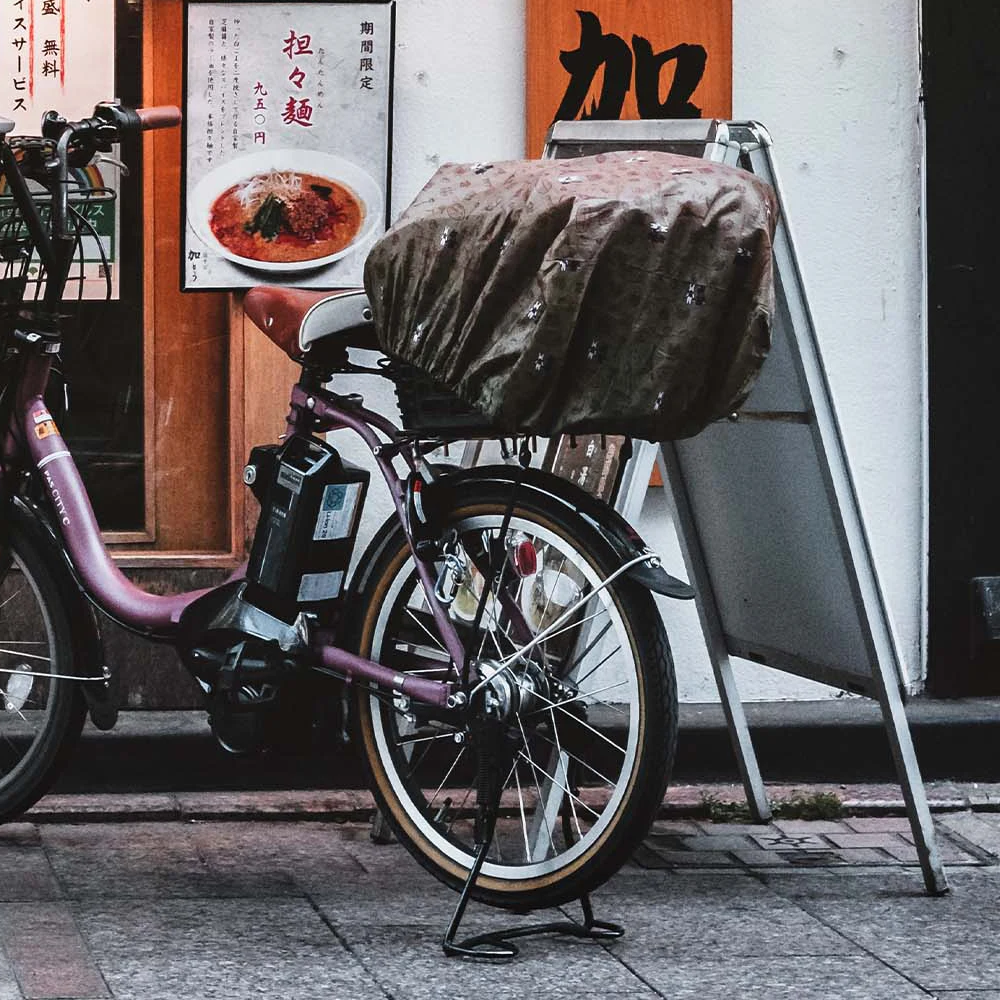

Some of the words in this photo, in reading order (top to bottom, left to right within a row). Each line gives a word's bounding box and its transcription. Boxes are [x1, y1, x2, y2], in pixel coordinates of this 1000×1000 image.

[41, 39, 60, 78] 無料
[281, 30, 314, 127] 担々麺
[359, 21, 375, 90] 期間限定
[553, 9, 708, 120] 加
[253, 82, 268, 145] 九五〇円
[51, 489, 68, 515] CITY
